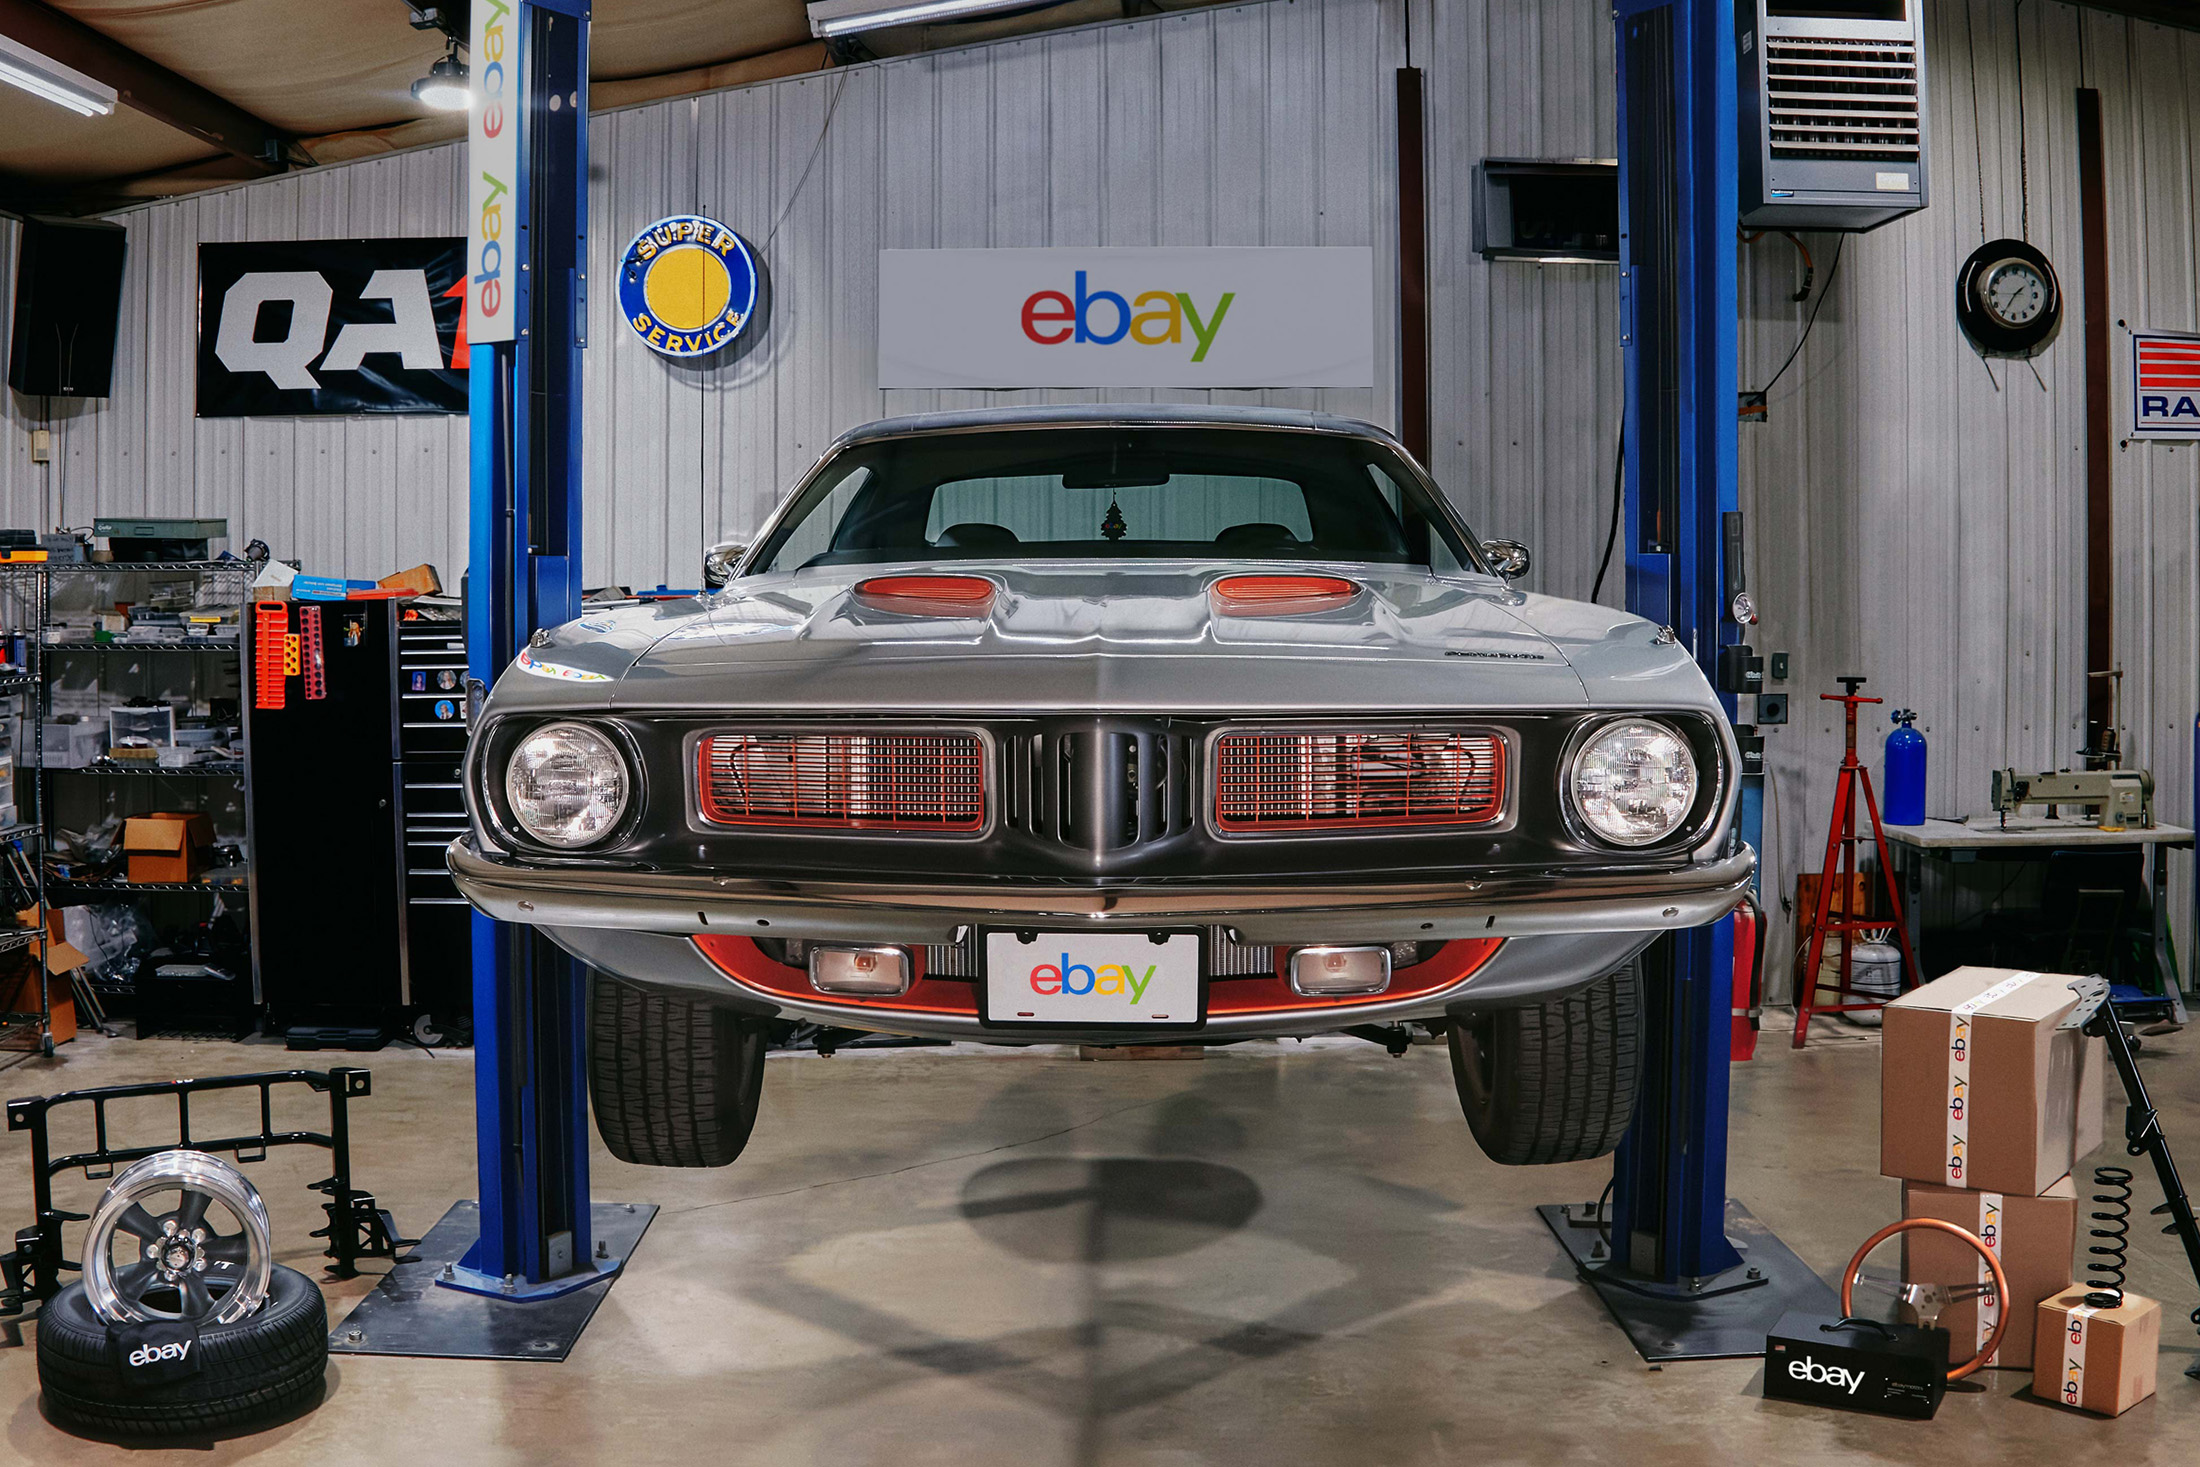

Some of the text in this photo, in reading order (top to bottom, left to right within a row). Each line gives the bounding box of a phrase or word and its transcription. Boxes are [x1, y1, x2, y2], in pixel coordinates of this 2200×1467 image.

[472, 171, 508, 318] ebay
[636, 221, 735, 260] SUPER
[632, 309, 745, 352] SERVICE
[1021, 270, 1236, 362] ebay
[1029, 952, 1157, 1005] ebay
[1948, 1016, 1970, 1179] ebay ebay ebay
[1981, 1202, 2000, 1248] ebay
[128, 1339, 192, 1367] ebay
[1788, 1355, 1866, 1395] ebay
[2063, 1358, 2082, 1405] ebay
